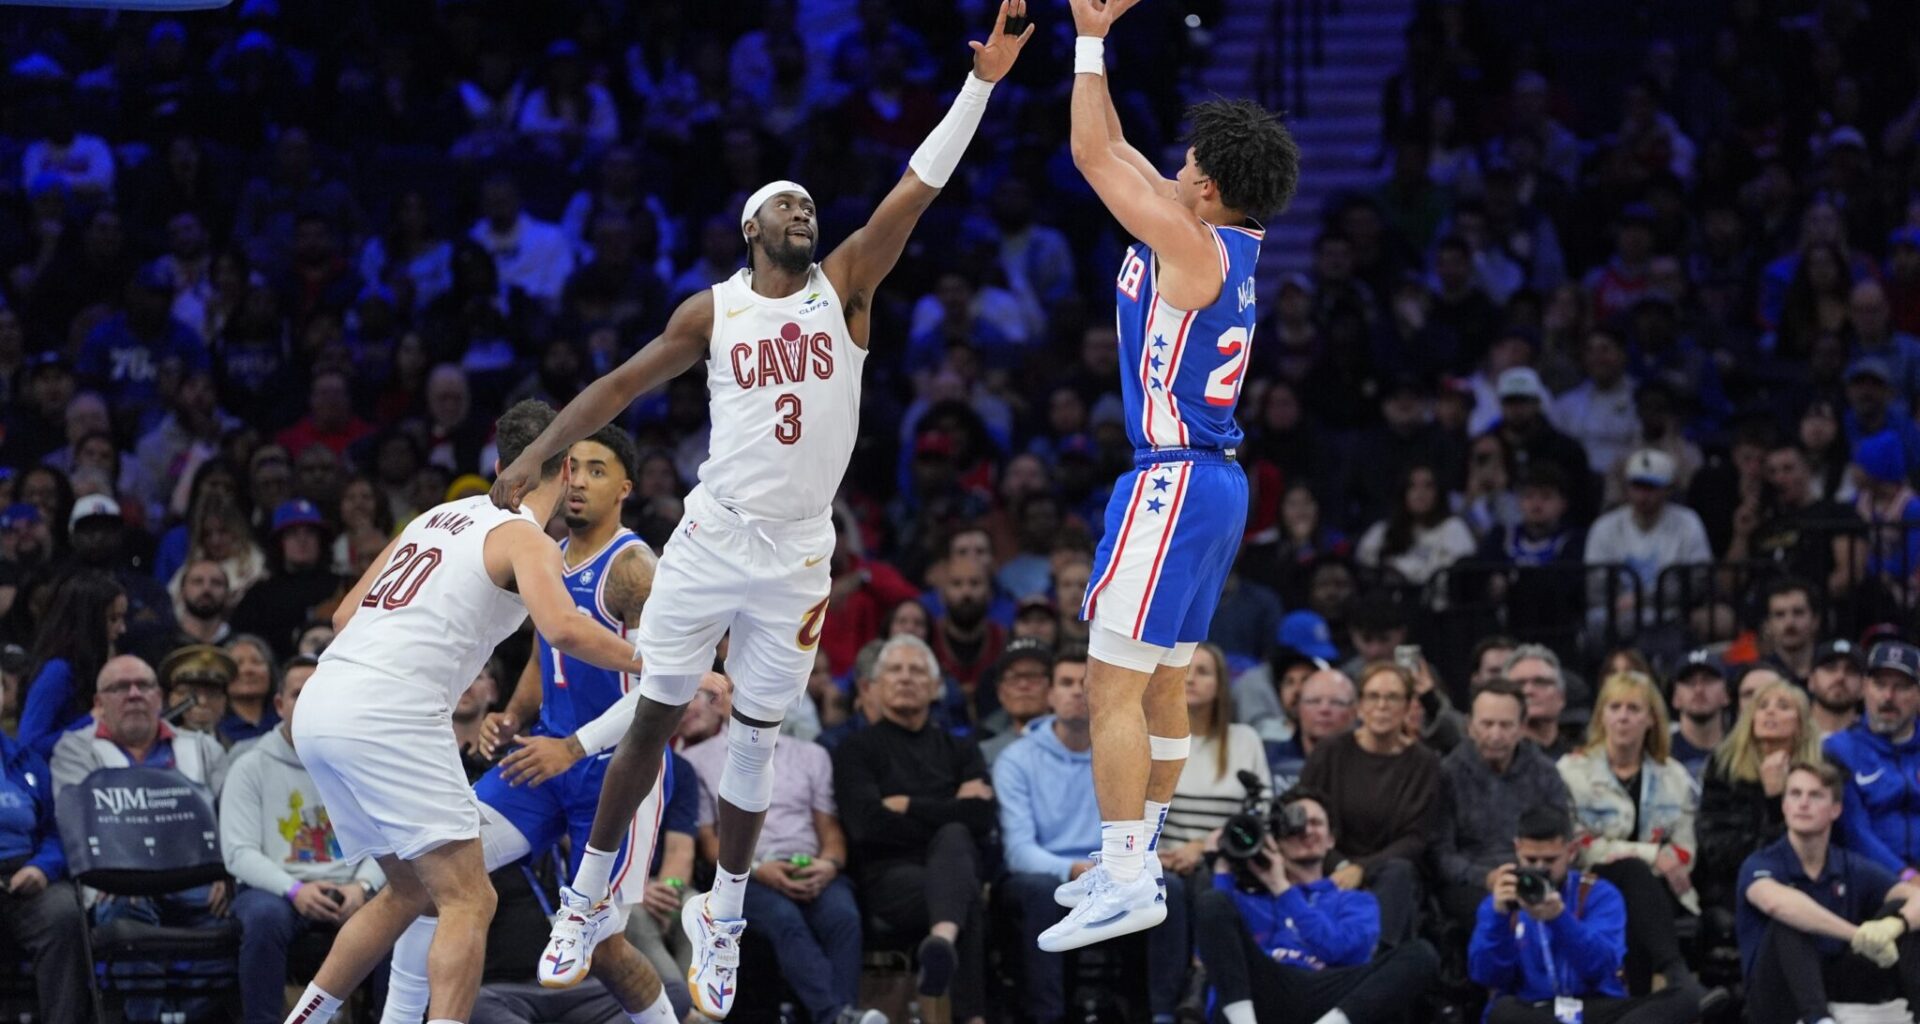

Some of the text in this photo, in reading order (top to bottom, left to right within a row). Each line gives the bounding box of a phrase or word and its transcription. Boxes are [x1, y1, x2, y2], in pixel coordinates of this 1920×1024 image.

[799, 300, 829, 315] CLIFFS
[731, 331, 834, 390] CAVS
[775, 393, 802, 445] 3
[424, 511, 475, 536] NIANG
[361, 543, 442, 611] 20
[92, 787, 148, 815] NJM
